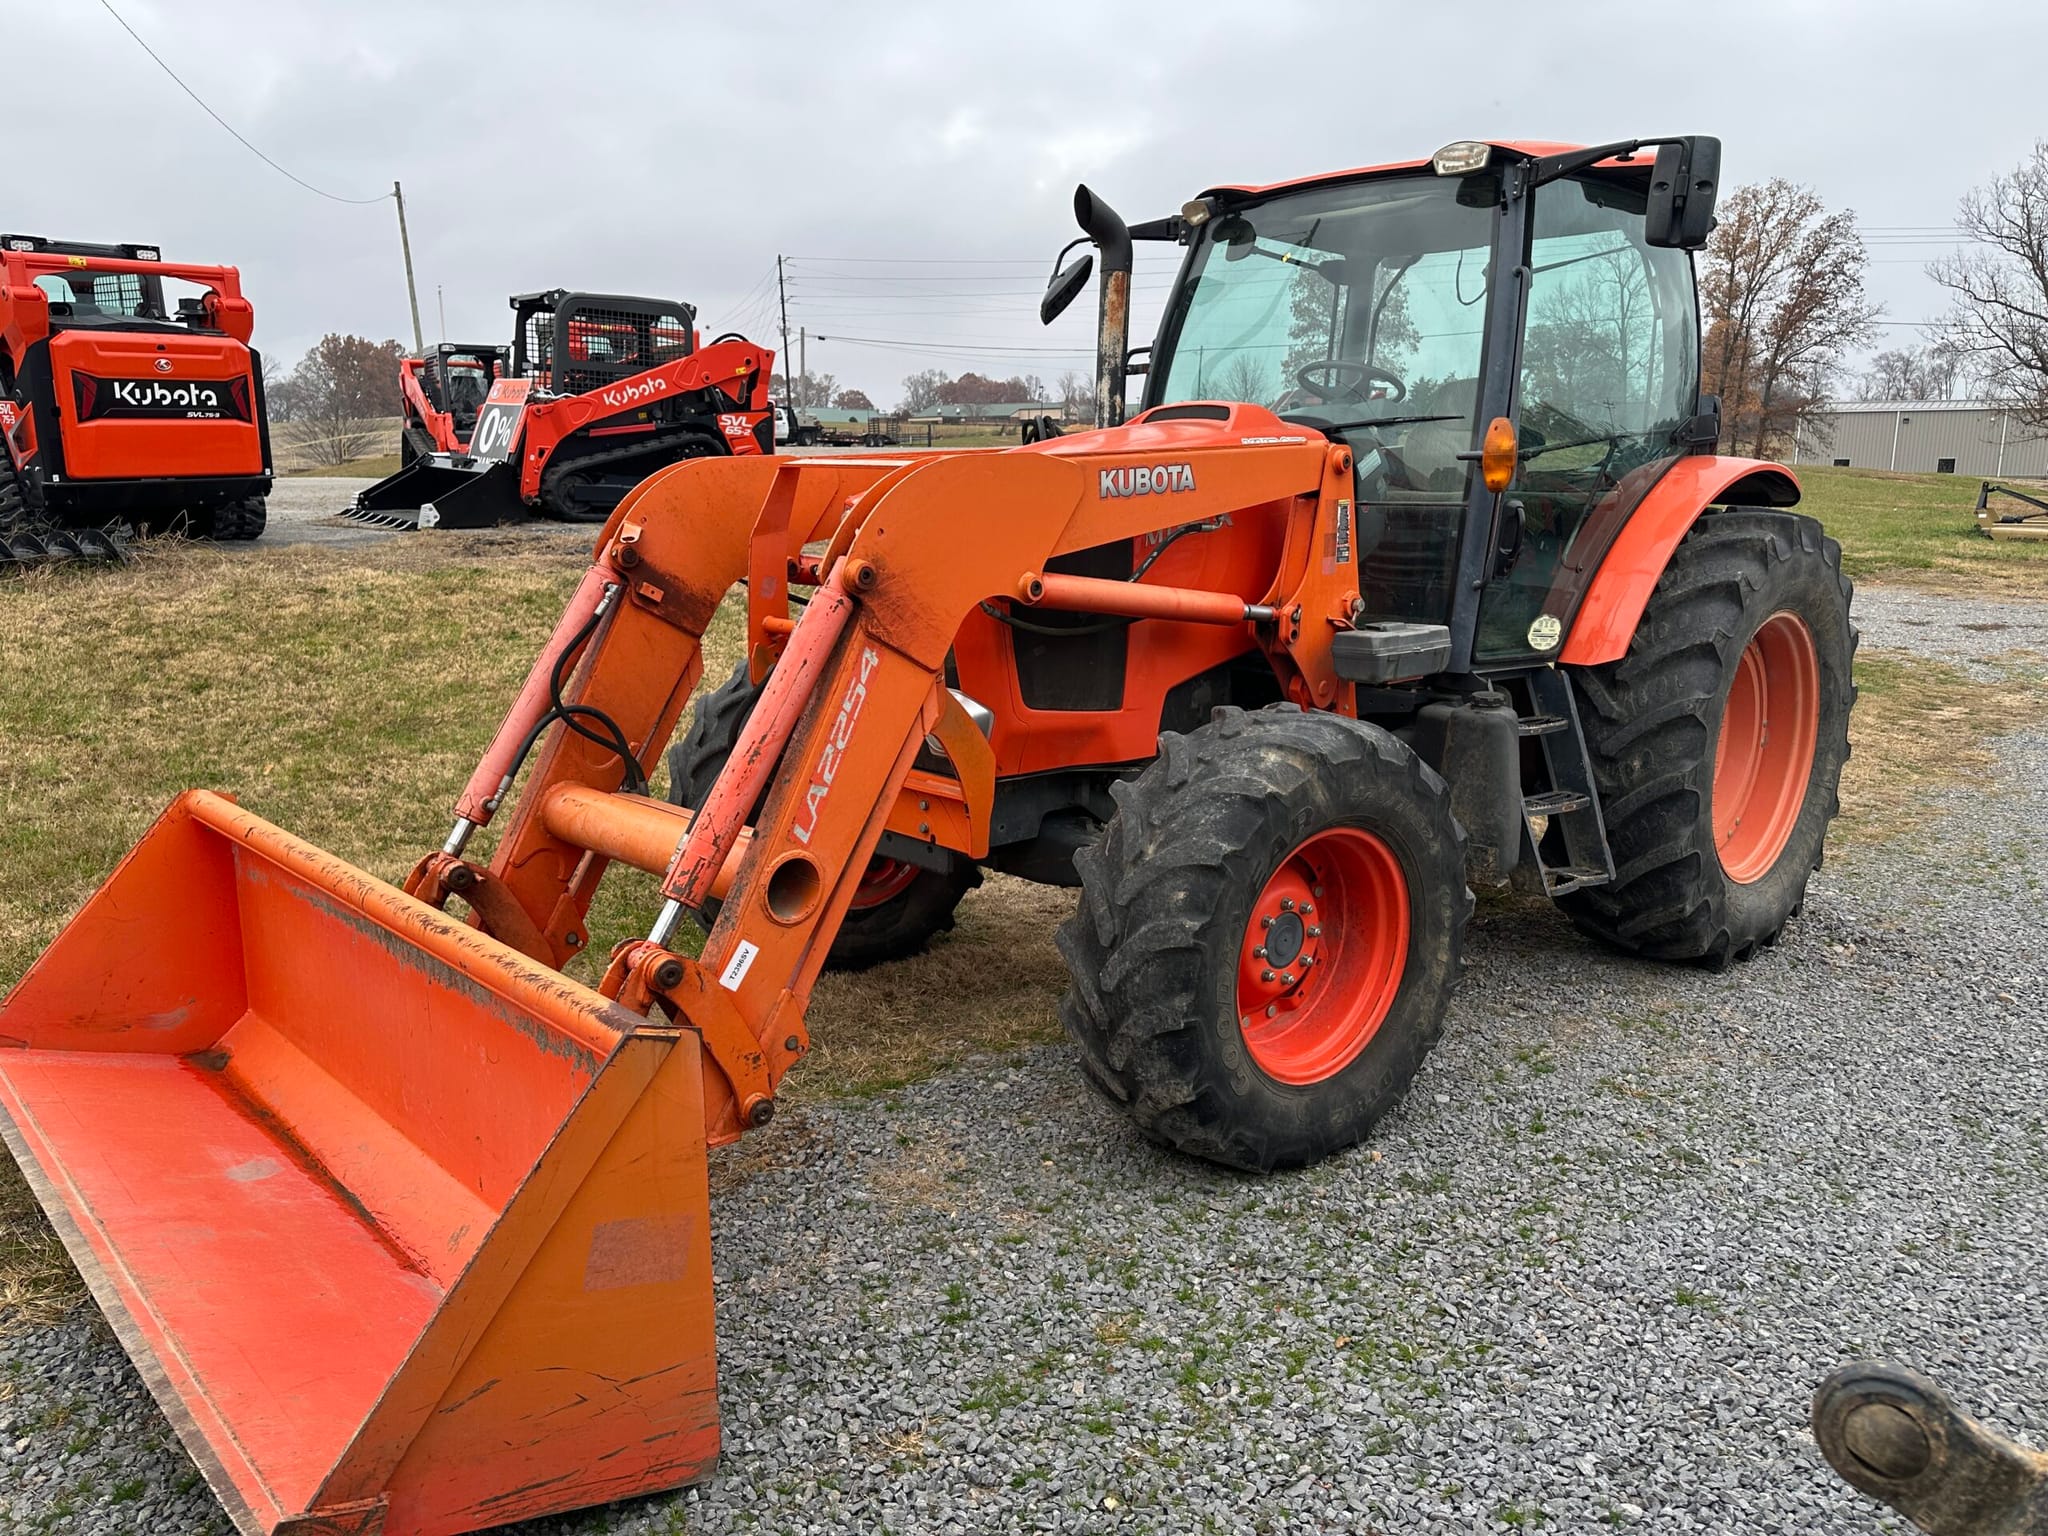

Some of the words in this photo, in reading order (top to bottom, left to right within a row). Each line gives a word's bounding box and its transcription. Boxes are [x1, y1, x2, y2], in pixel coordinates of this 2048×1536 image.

[113, 381, 218, 406] Kubota
[603, 377, 667, 407] Kubota
[478, 407, 513, 454] 0%
[719, 414, 753, 428] SVL
[725, 425, 751, 436] 65-2
[1099, 463, 1196, 499] KUBOTA
[793, 646, 879, 844] LA2254
